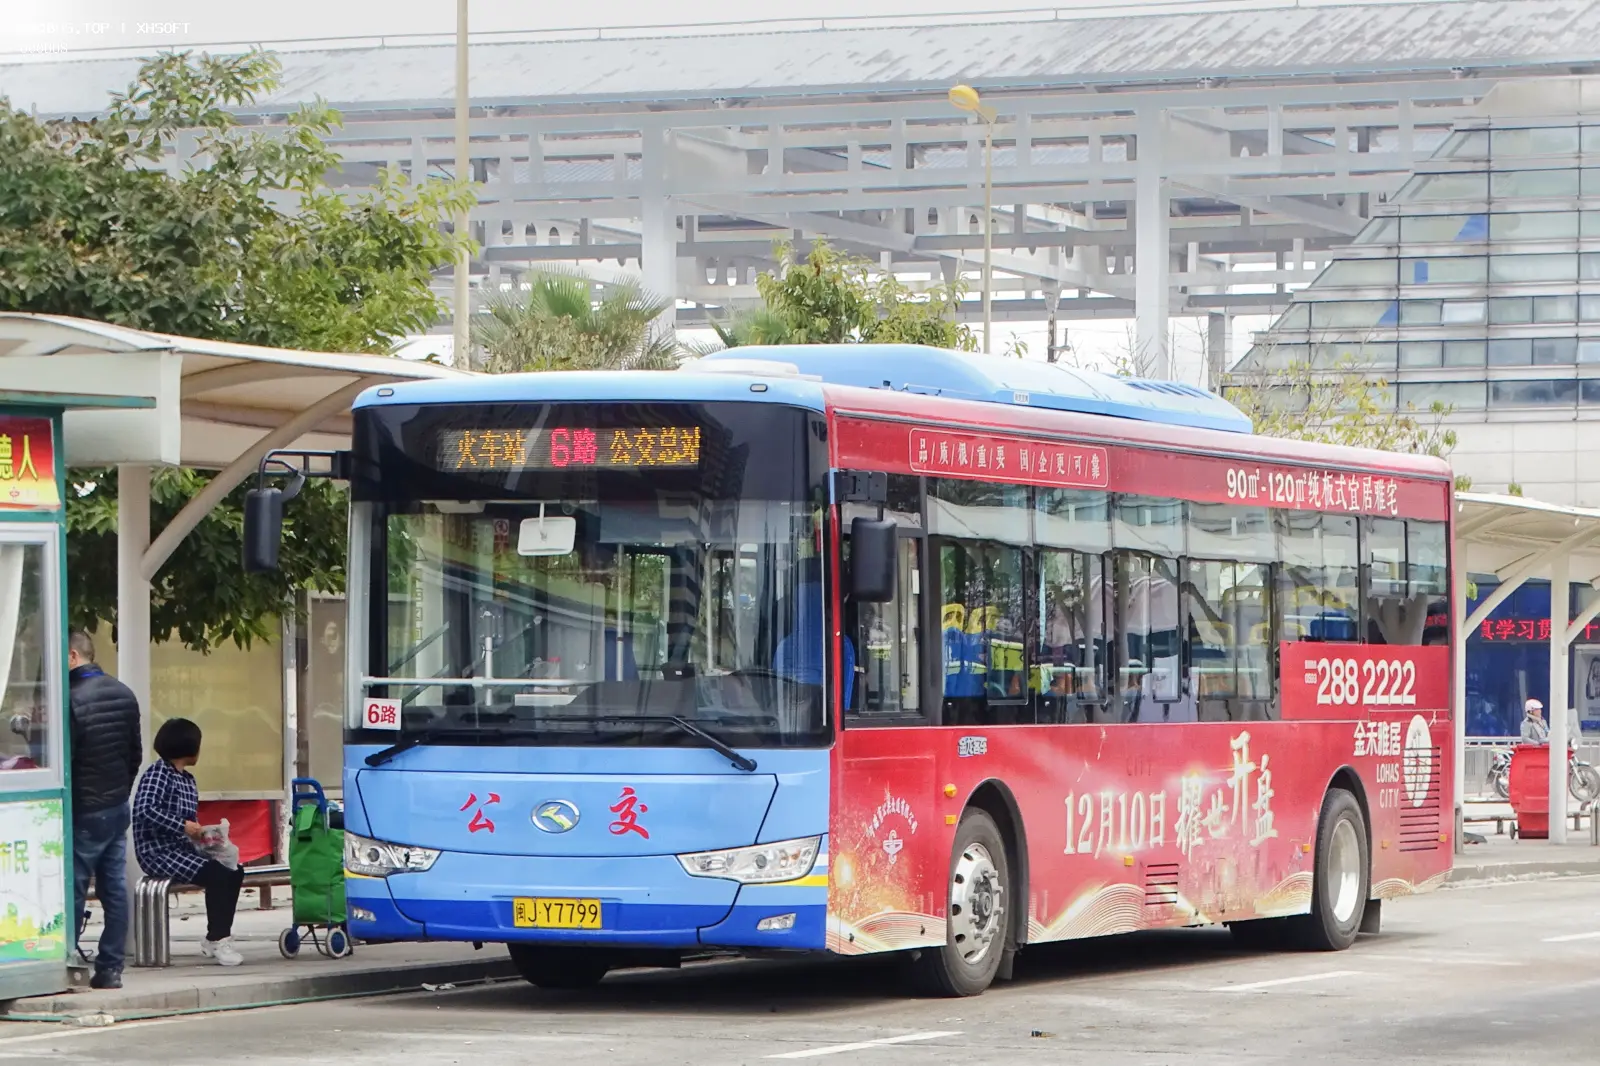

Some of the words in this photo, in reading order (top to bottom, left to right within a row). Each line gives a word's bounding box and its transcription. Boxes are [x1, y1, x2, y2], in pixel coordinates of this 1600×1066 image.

[457, 429, 527, 468] 火车站
[550, 427, 598, 467] 6路
[610, 426, 701, 465] 公交总站
[1317, 658, 1360, 706] 288
[1362, 659, 1417, 706] 2222
[367, 703, 397, 725] 6路
[1376, 762, 1400, 783] LOHAS
[1379, 788, 1400, 809] CITY
[1063, 788, 1167, 861] 12月10日
